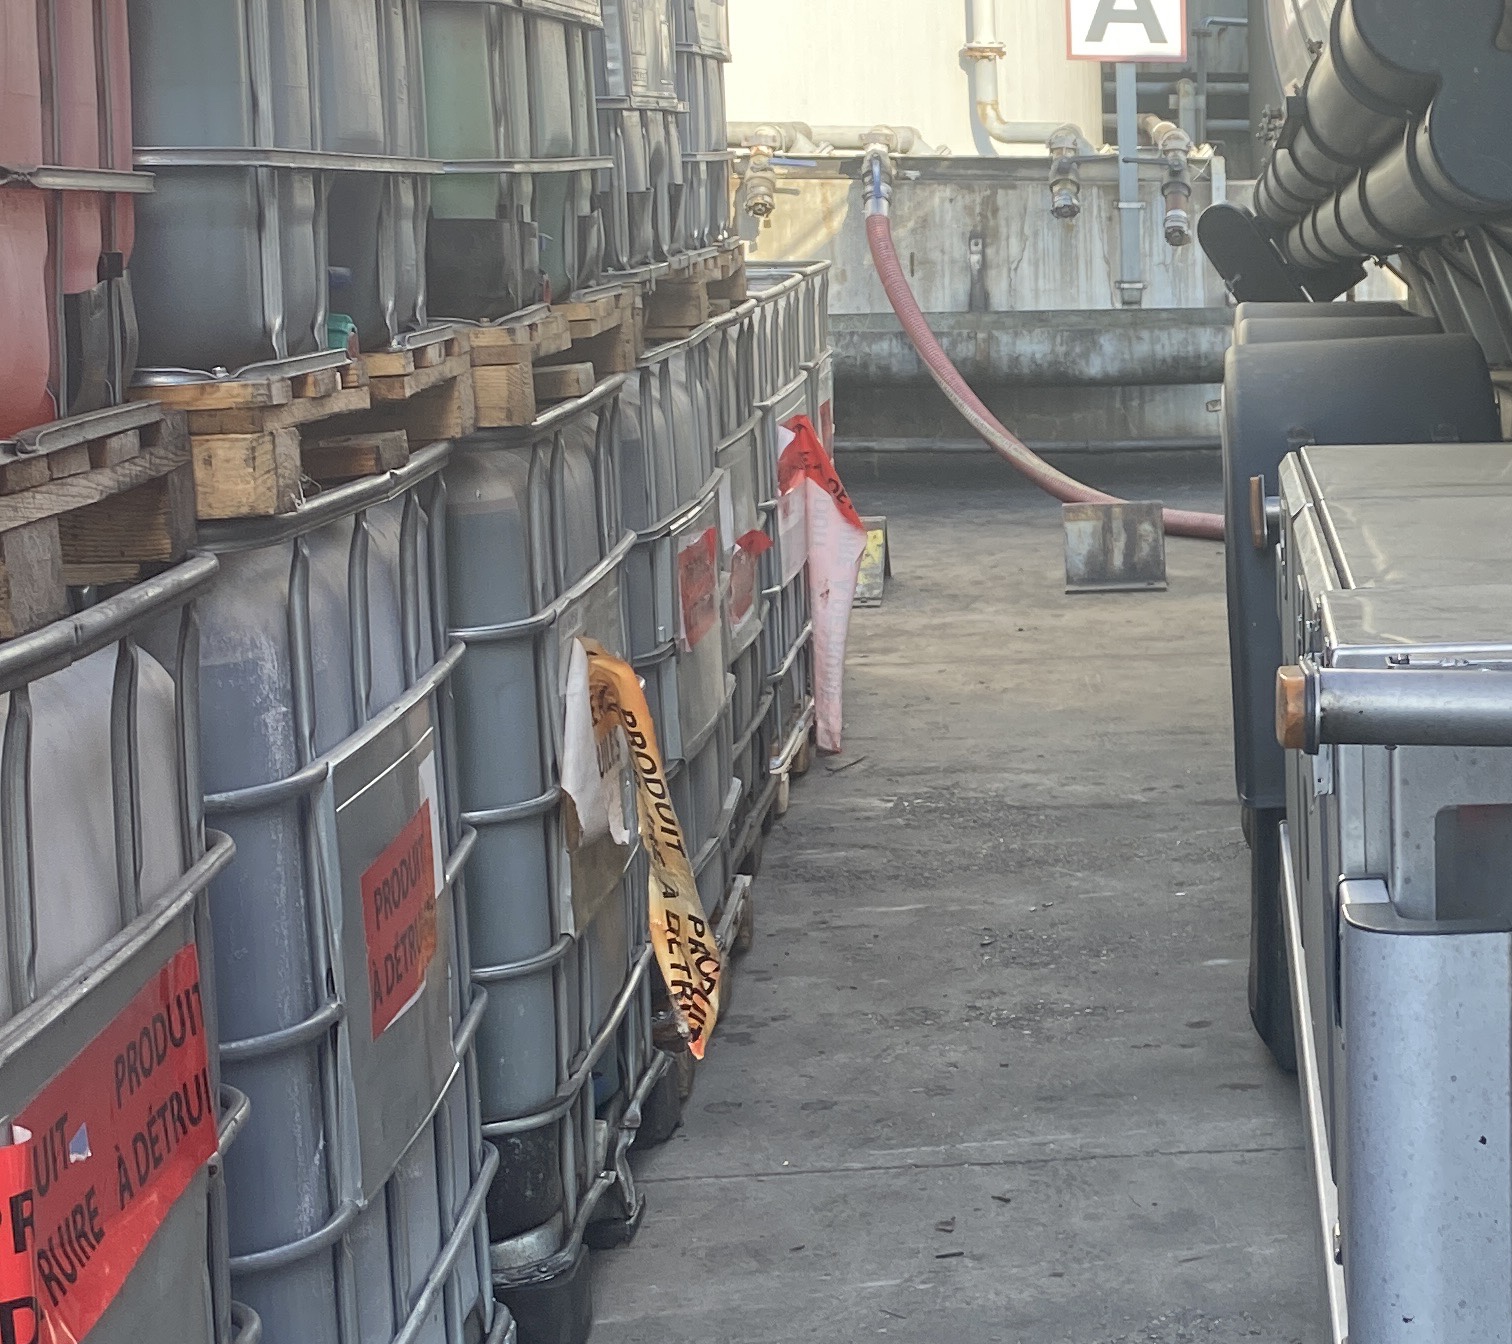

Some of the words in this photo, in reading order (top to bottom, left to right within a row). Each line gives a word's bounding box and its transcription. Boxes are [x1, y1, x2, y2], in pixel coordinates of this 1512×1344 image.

[622, 708, 687, 859] PRODUIT
[374, 833, 424, 931] PRODUIT
[114, 982, 205, 1109] PRODUIT
[36, 1184, 106, 1308] RUIRE
[115, 1145, 135, 1212] À
